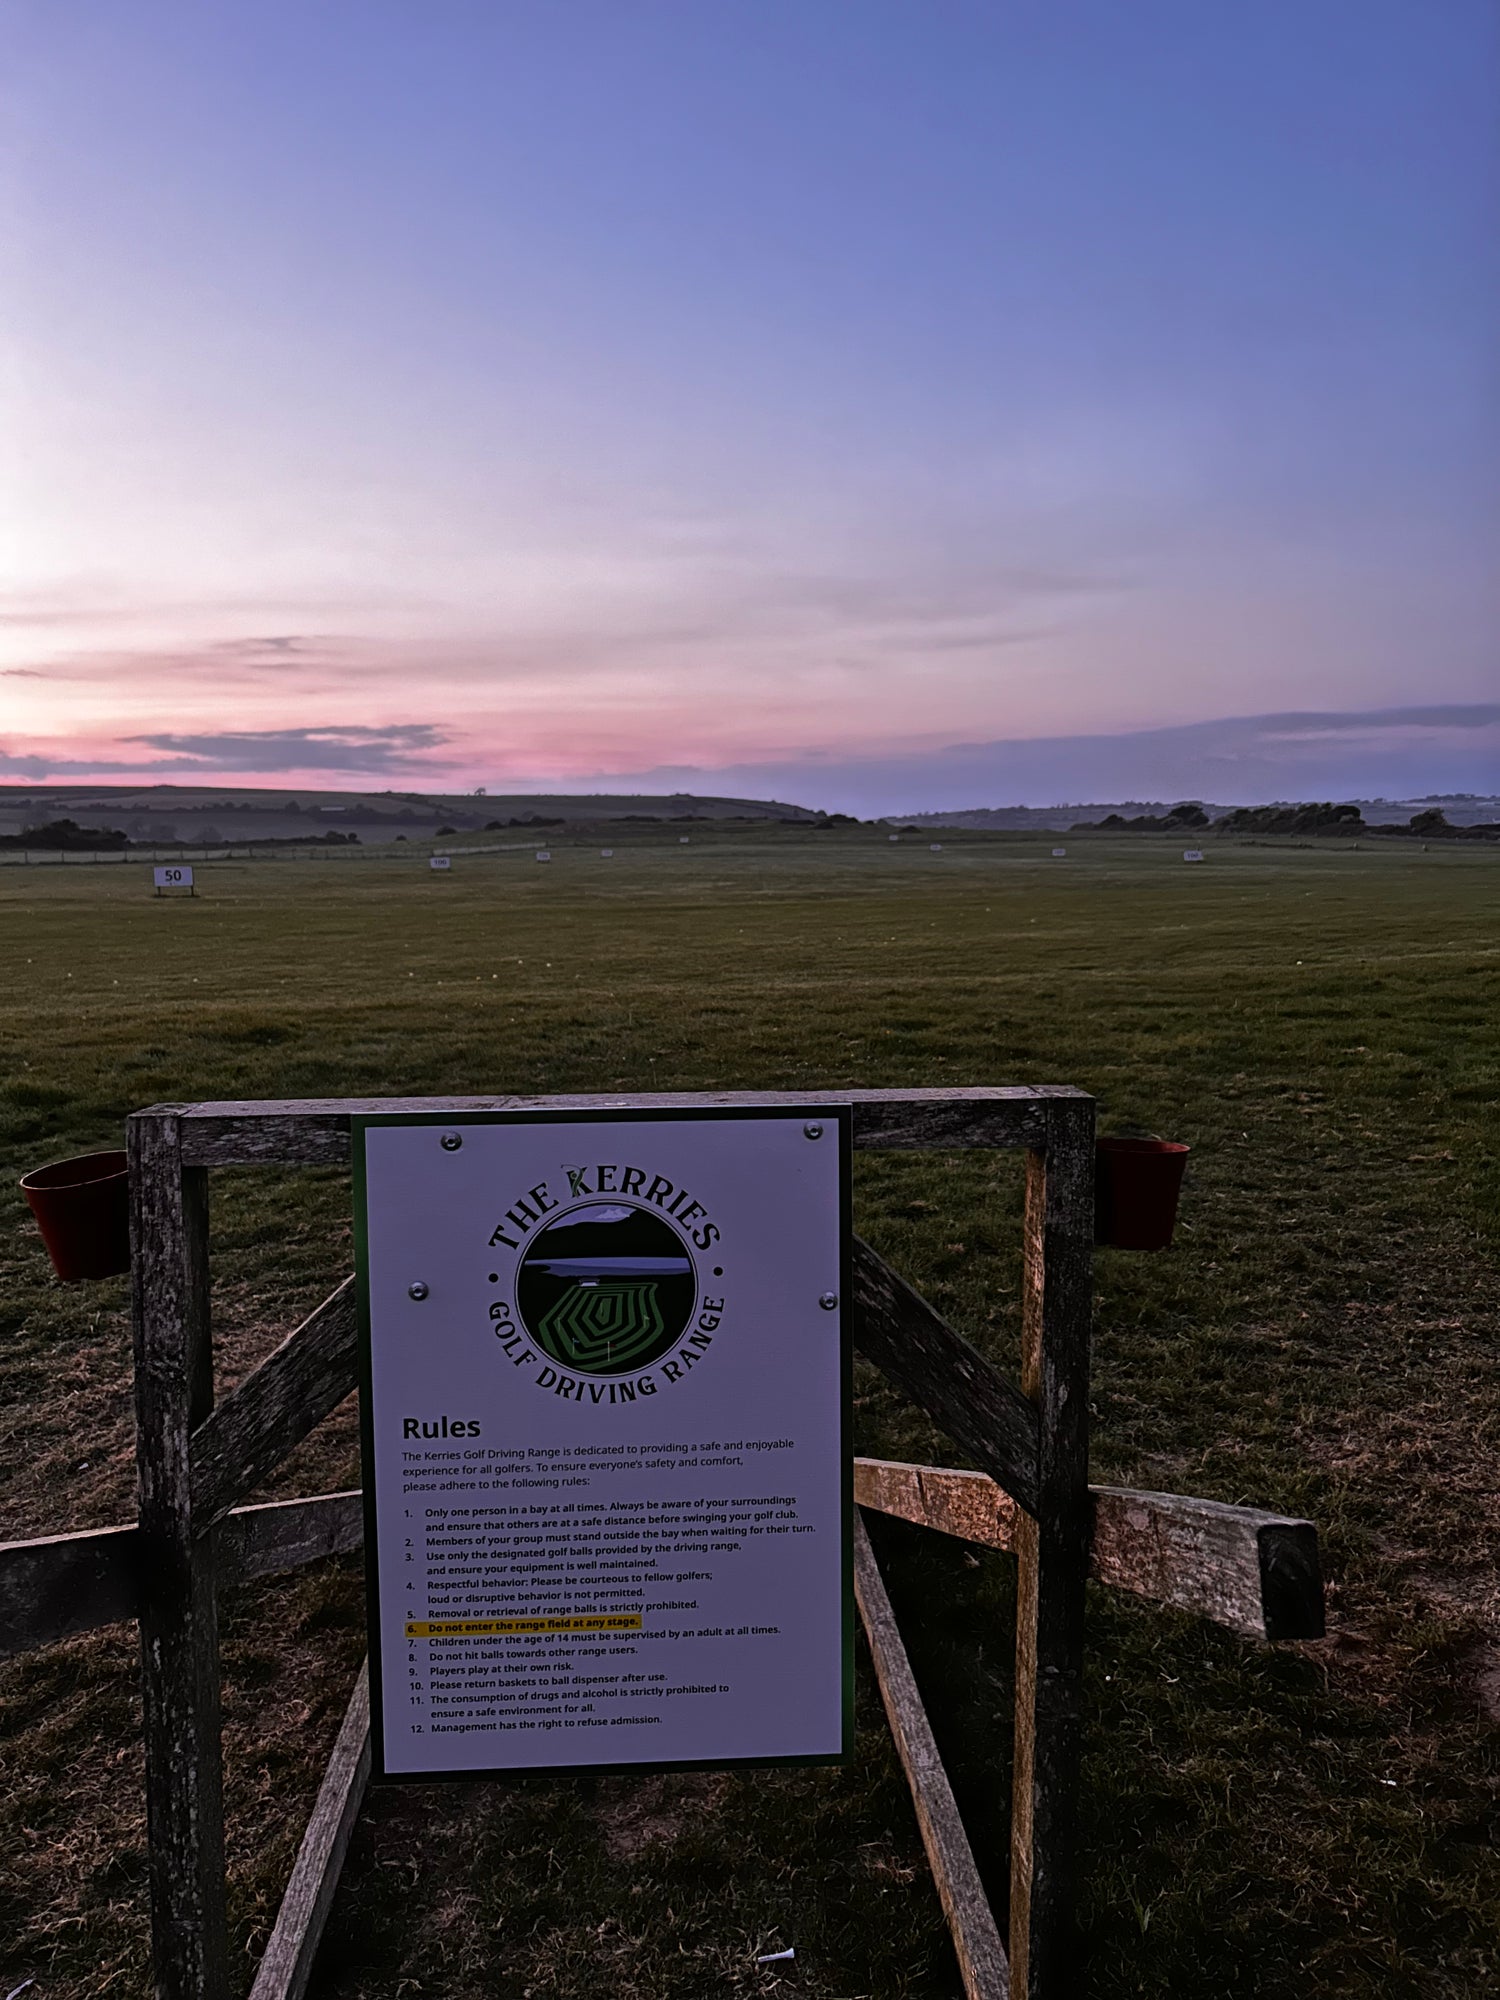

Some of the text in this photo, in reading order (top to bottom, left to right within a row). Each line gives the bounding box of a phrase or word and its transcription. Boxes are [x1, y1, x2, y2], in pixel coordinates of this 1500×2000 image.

[165, 870, 182, 882] 50
[488, 1165, 720, 1251] THE KERRIES
[488, 1295, 725, 1403] GOLF DRIVING RANGE
[402, 1416, 481, 1440] Rules
[402, 1451, 422, 1461] The
[424, 1450, 461, 1460] Kerries
[463, 1449, 486, 1459] Golf
[487, 1448, 525, 1460] Driving
[527, 1447, 561, 1459] Range
[563, 1446, 572, 1456] is
[573, 1445, 625, 1455] dedicated
[626, 1445, 638, 1454] to
[640, 1443, 689, 1456] providing
[699, 1442, 721, 1451] safe
[723, 1441, 743, 1451] and
[745, 1439, 794, 1452] enjoyable
[402, 1465, 460, 1479] experience
[462, 1465, 478, 1474] for
[480, 1464, 492, 1474] all
[494, 1463, 534, 1476] golfers.
[535, 1463, 549, 1472] To
[645, 1458, 676, 1471] safety
[678, 1458, 698, 1467] and
[700, 1456, 744, 1468] comfort,
[403, 1476, 590, 1494] please adhere to the following rules:
[404, 1509, 414, 1518] 1.
[425, 1508, 449, 1519] Only
[472, 1508, 507, 1518] person
[509, 1505, 519, 1514] in
[529, 1505, 548, 1516] bay
[550, 1505, 561, 1513] at
[562, 1504, 575, 1513] all
[577, 1503, 608, 1512] times.
[609, 1501, 645, 1513] Always
[646, 1501, 659, 1510] be
[693, 1499, 704, 1508] of
[705, 1501, 729, 1510] your
[731, 1496, 796, 1509] surroundings
[405, 1525, 816, 1547] 2. Members of your group must stand outside the bay when waiting for their turn.
[405, 1542, 742, 1562] 3. Use only the designated golf balls provided by the driving range,
[406, 1582, 416, 1590] 4.
[427, 1579, 480, 1592] Respectful
[531, 1576, 563, 1586] Please
[565, 1576, 578, 1584] be
[579, 1575, 629, 1584] courteous
[631, 1574, 642, 1582] to
[644, 1572, 674, 1582] fellow
[408, 1617, 639, 1633] 6. Do not enter the range field at any stage.
[408, 1639, 417, 1648] 7.
[429, 1637, 471, 1647] Children
[473, 1636, 503, 1645] under
[505, 1635, 522, 1644] the
[524, 1636, 542, 1645] age
[544, 1634, 556, 1642] of
[557, 1634, 569, 1642] 14
[571, 1633, 597, 1641] must
[598, 1631, 611, 1640] be
[613, 1629, 667, 1642] supervised
[668, 1629, 680, 1640] by
[697, 1627, 723, 1636] adult
[737, 1626, 749, 1635] all
[751, 1625, 781, 1634] times.
[409, 1661, 574, 1678] 9. Players play at their own risk.
[409, 1682, 424, 1690] 10.
[430, 1680, 462, 1690] Please
[464, 1680, 496, 1688] return
[498, 1677, 537, 1687] baskets
[551, 1676, 570, 1685] ball
[571, 1674, 620, 1686] dispenser
[621, 1673, 646, 1682] after
[410, 1697, 424, 1705] 11.
[430, 1695, 449, 1704] The
[451, 1692, 516, 1706] consumption
[518, 1692, 529, 1701] of
[530, 1691, 560, 1702] drugs
[561, 1690, 580, 1699] and
[582, 1688, 618, 1698] alcohol
[620, 1688, 628, 1696] is
[630, 1686, 664, 1698] strictly
[666, 1684, 717, 1697] prohibited
[411, 1715, 663, 1735] 12. Management has the right to refuse admission.
